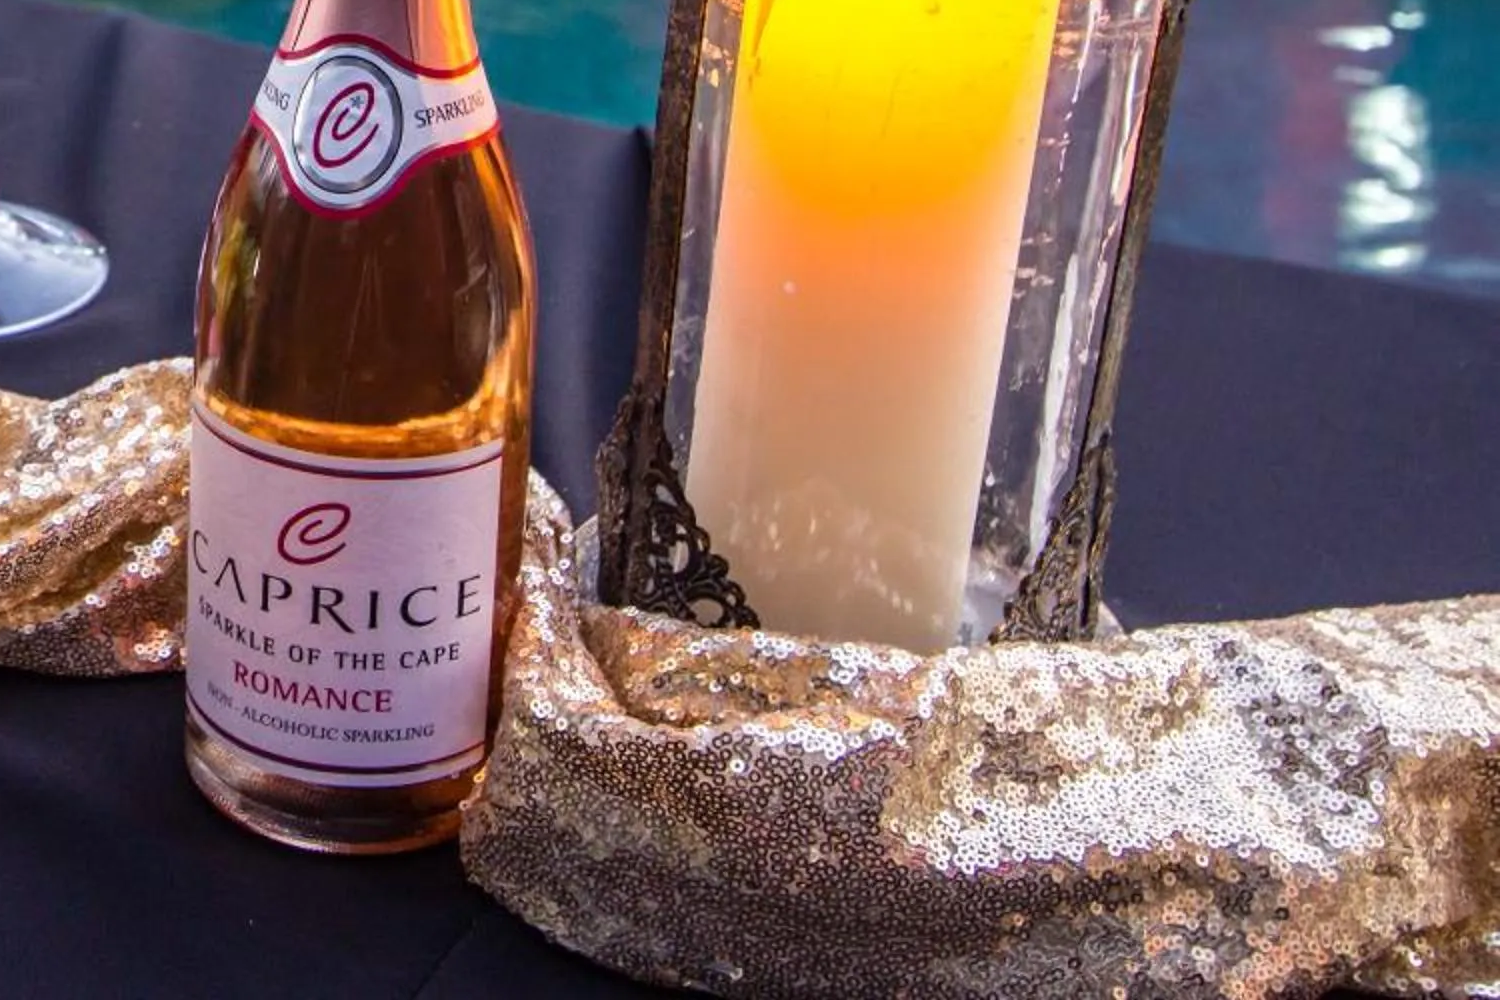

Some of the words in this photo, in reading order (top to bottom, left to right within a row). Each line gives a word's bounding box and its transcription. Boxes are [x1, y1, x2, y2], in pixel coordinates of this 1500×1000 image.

[413, 89, 485, 129] SPARKLING
[192, 529, 482, 635] CAPRICE
[198, 594, 276, 656] SPARKLE
[288, 643, 321, 665] OF
[333, 651, 386, 671] THE
[399, 641, 461, 669] CAPE
[207, 680, 234, 709] NON
[241, 705, 339, 741] ALCOHOLIC
[341, 723, 436, 743] SPARKLING
[232, 659, 394, 713] ROMANCE
